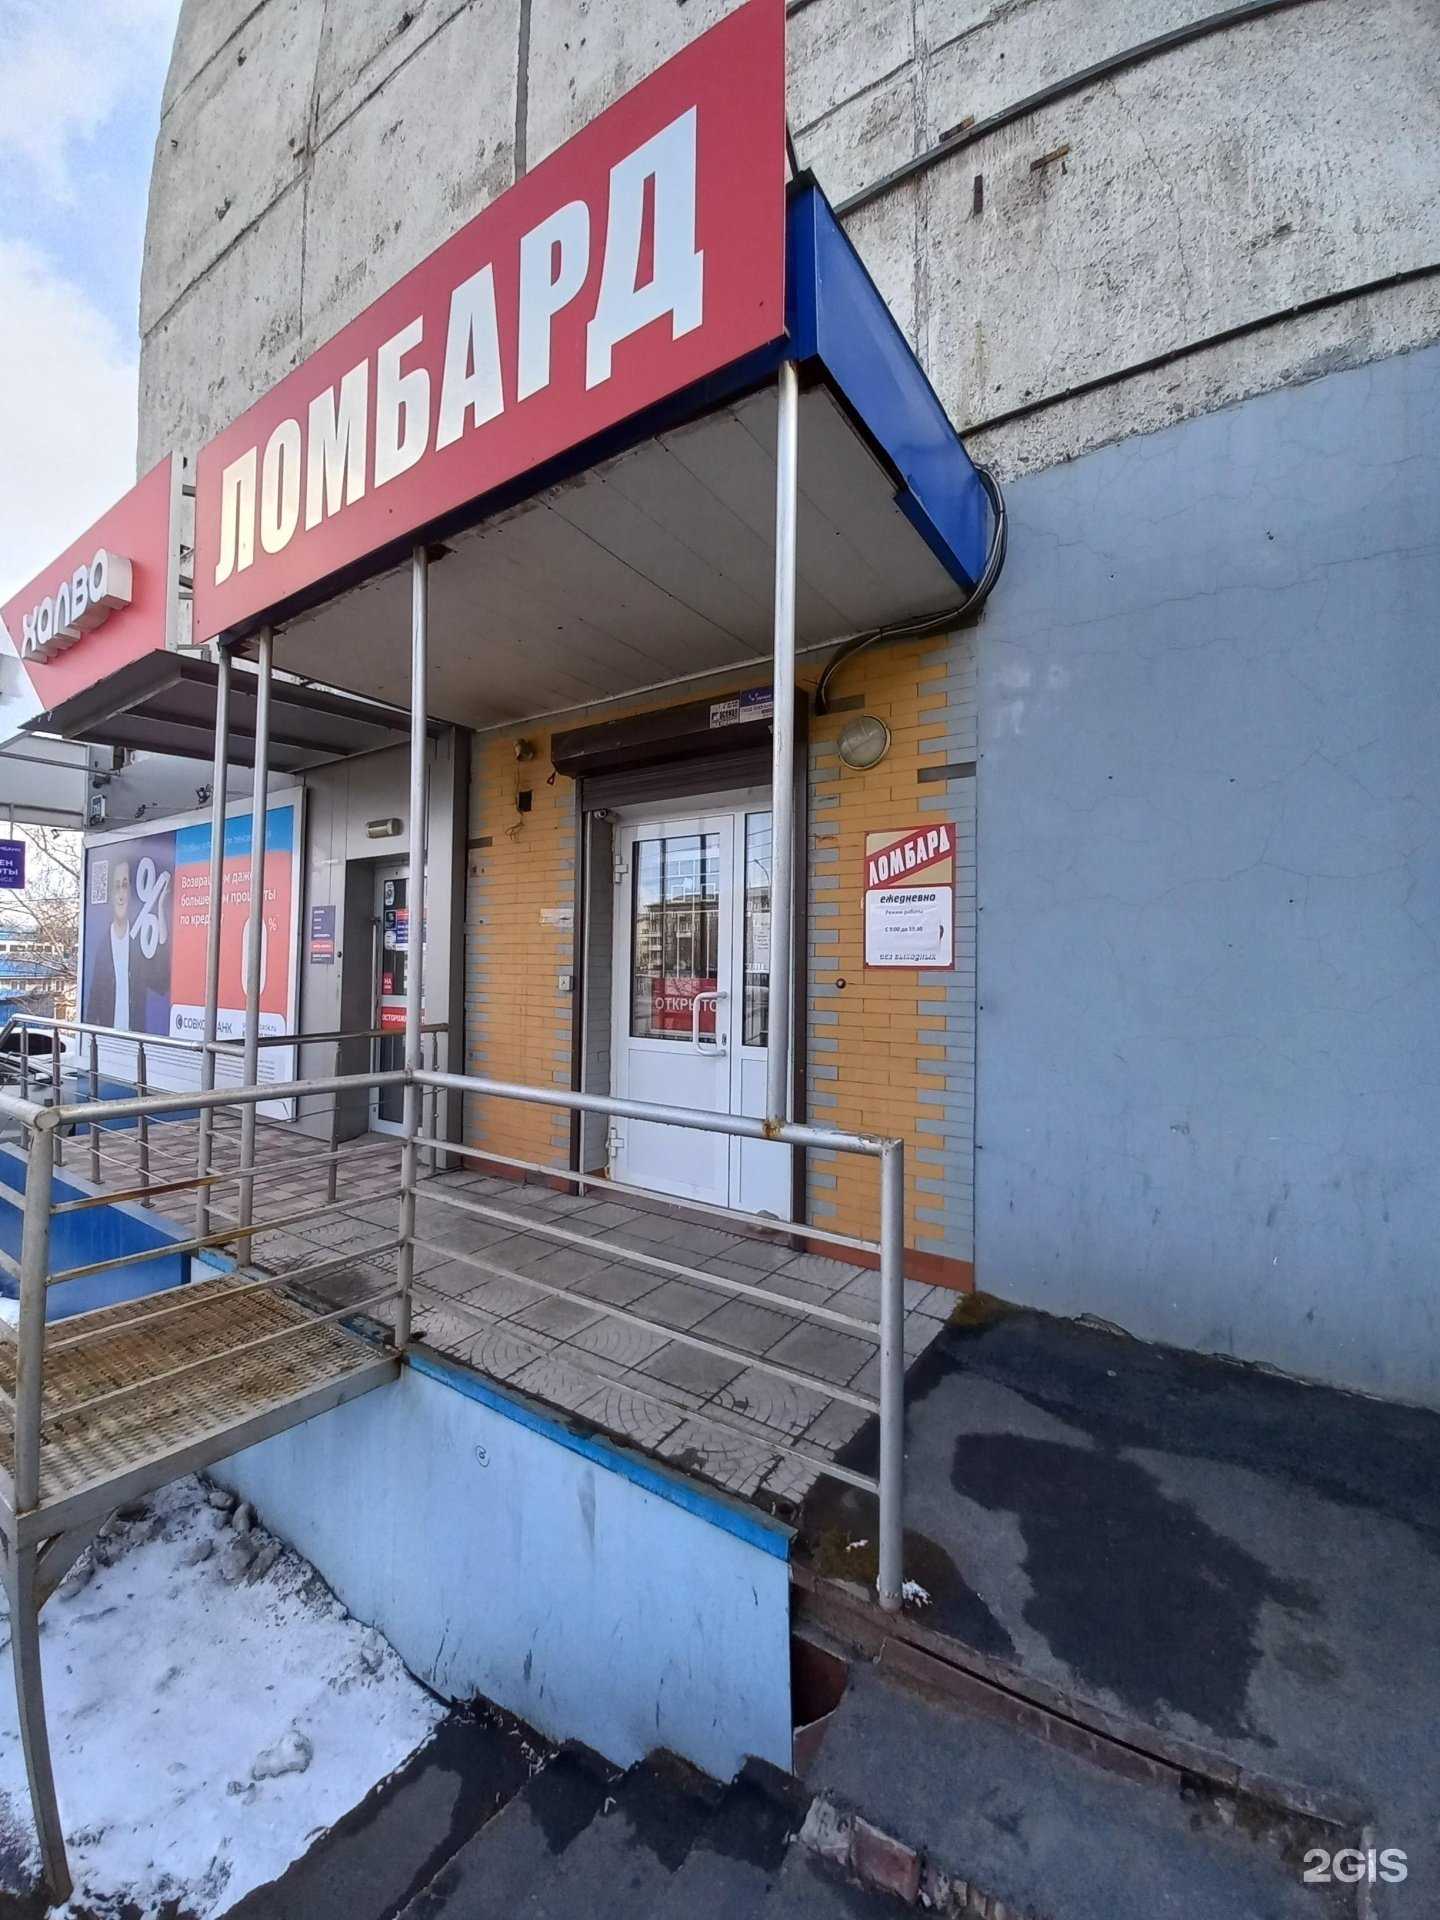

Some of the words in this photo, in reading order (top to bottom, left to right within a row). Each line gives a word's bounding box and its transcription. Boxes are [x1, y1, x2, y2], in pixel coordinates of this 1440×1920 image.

[215, 104, 704, 586] ЛОМБАРД
[869, 825, 951, 887] ЛОМБАРД
[880, 894, 936, 904] ежедневно
[180, 914, 190, 926] по
